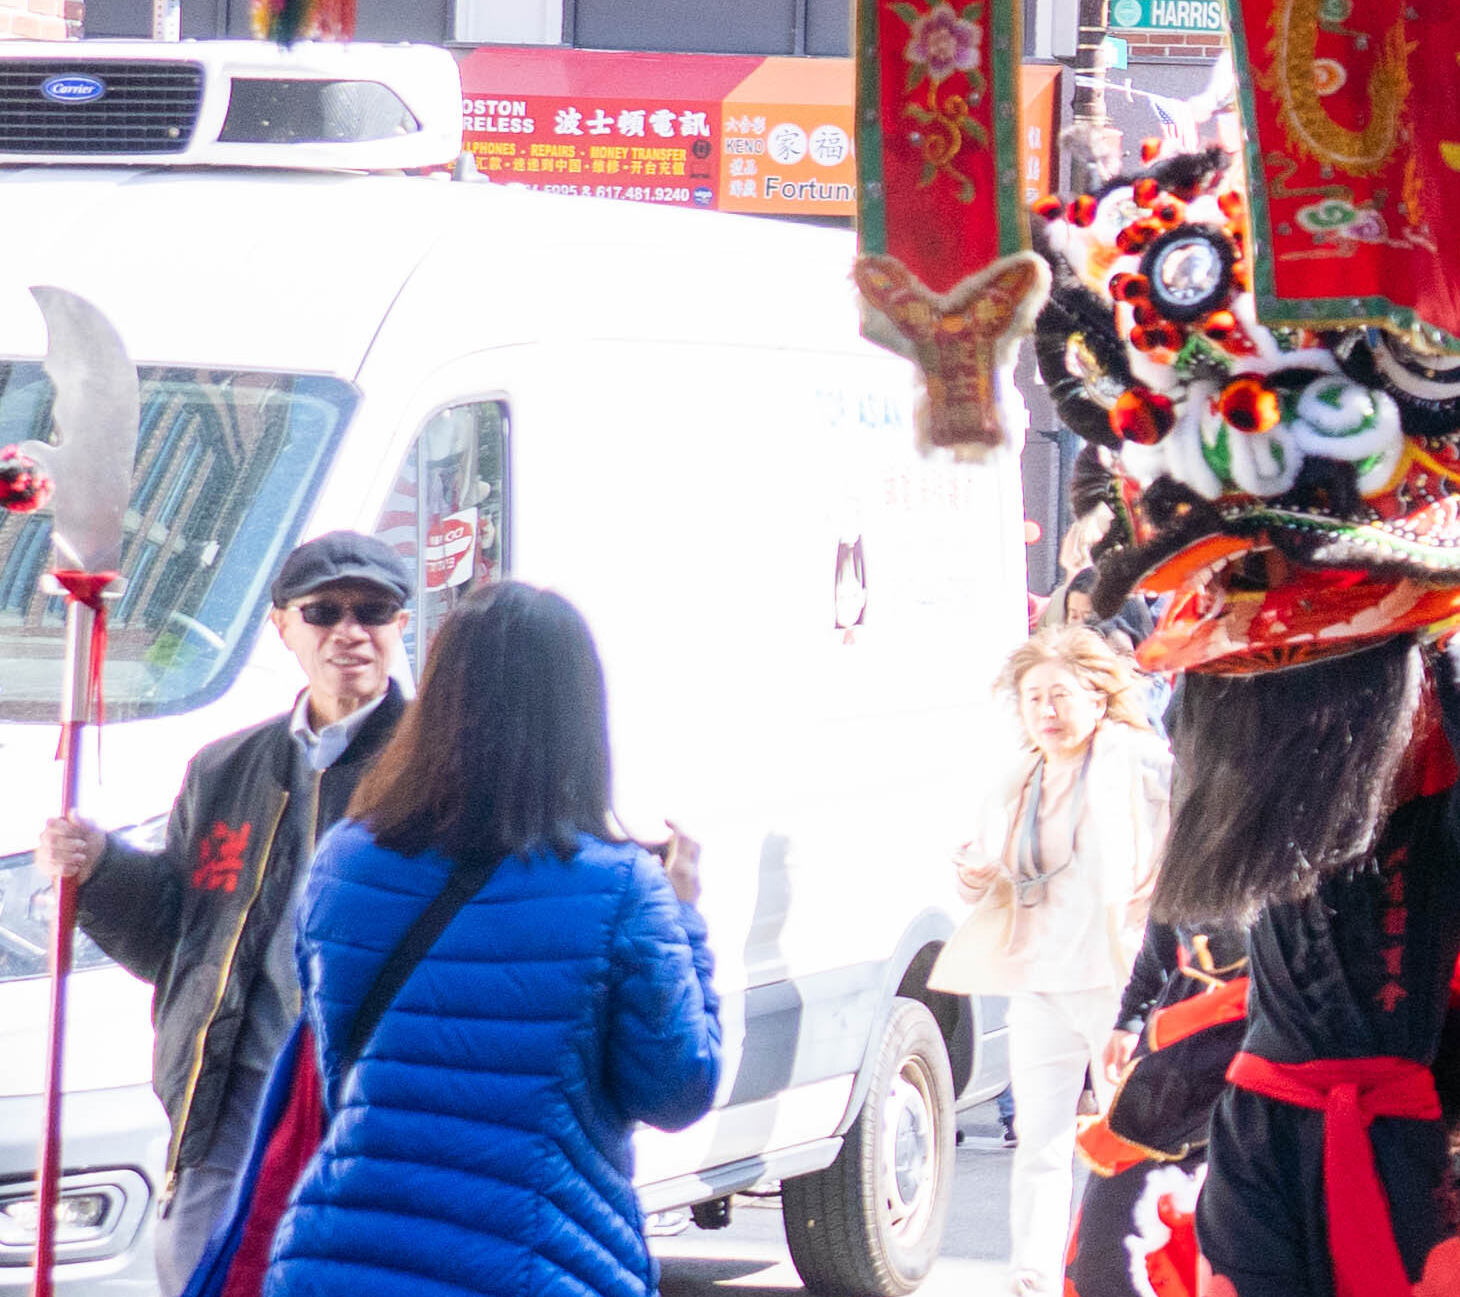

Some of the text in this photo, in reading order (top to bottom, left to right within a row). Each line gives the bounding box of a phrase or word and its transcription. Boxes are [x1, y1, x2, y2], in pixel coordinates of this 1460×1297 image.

[50, 81, 97, 97] Carrier
[462, 99, 527, 117] OSTON
[463, 116, 536, 134] RELESS
[553, 106, 711, 138] 波士頓電訊
[530, 143, 576, 159] REPAIRS
[589, 146, 630, 160] MONEY
[631, 147, 687, 162] TRANSFER
[725, 138, 765, 155] KENO
